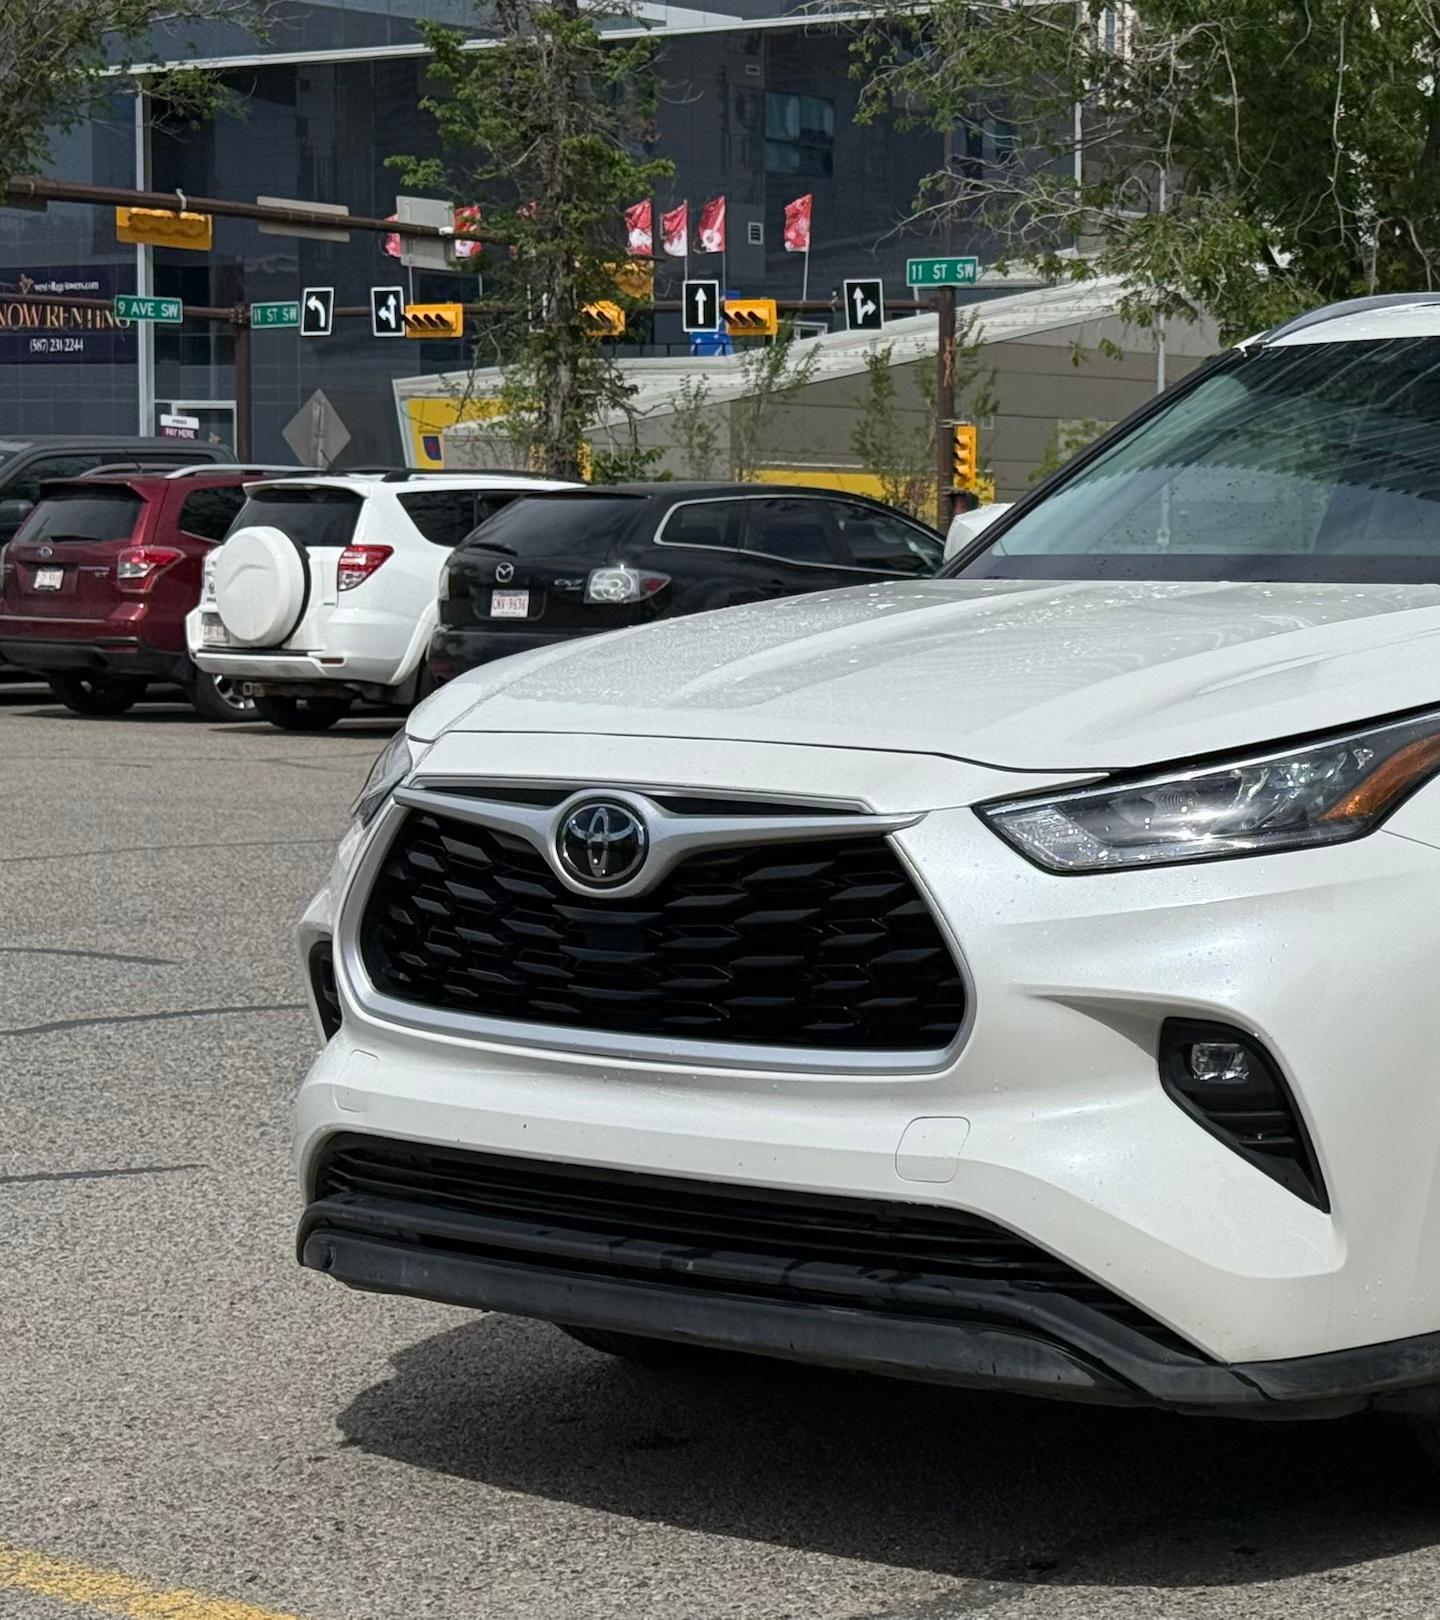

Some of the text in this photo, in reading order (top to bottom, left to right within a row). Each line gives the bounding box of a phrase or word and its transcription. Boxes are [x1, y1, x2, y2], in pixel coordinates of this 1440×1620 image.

[911, 263, 974, 280] 11 ST SW
[118, 301, 178, 318] 9 AVE SW
[267, 308, 278, 322] ST
[282, 307, 297, 321] SW
